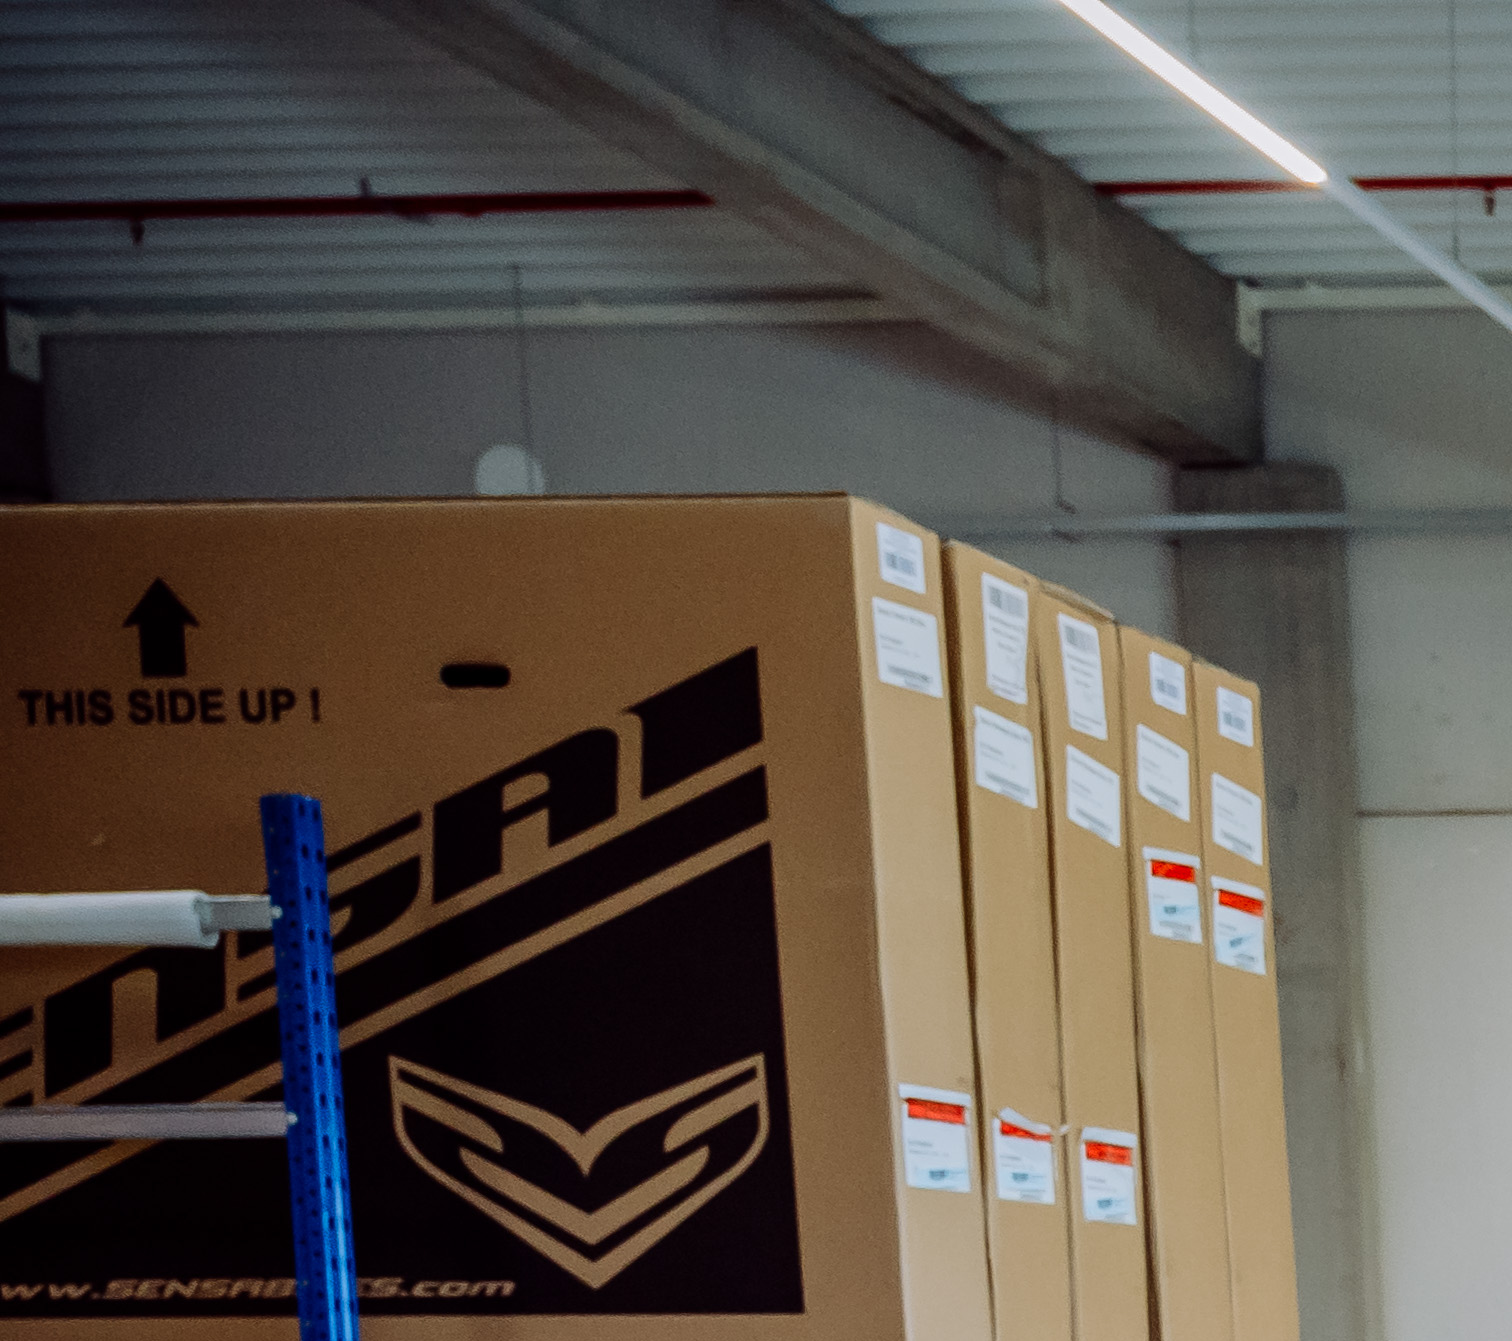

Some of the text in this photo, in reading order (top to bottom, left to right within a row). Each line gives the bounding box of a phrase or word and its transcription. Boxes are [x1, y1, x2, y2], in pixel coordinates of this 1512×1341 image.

[18, 688, 114, 726] THIS
[128, 687, 226, 725] SIDE
[239, 687, 296, 724] UP
